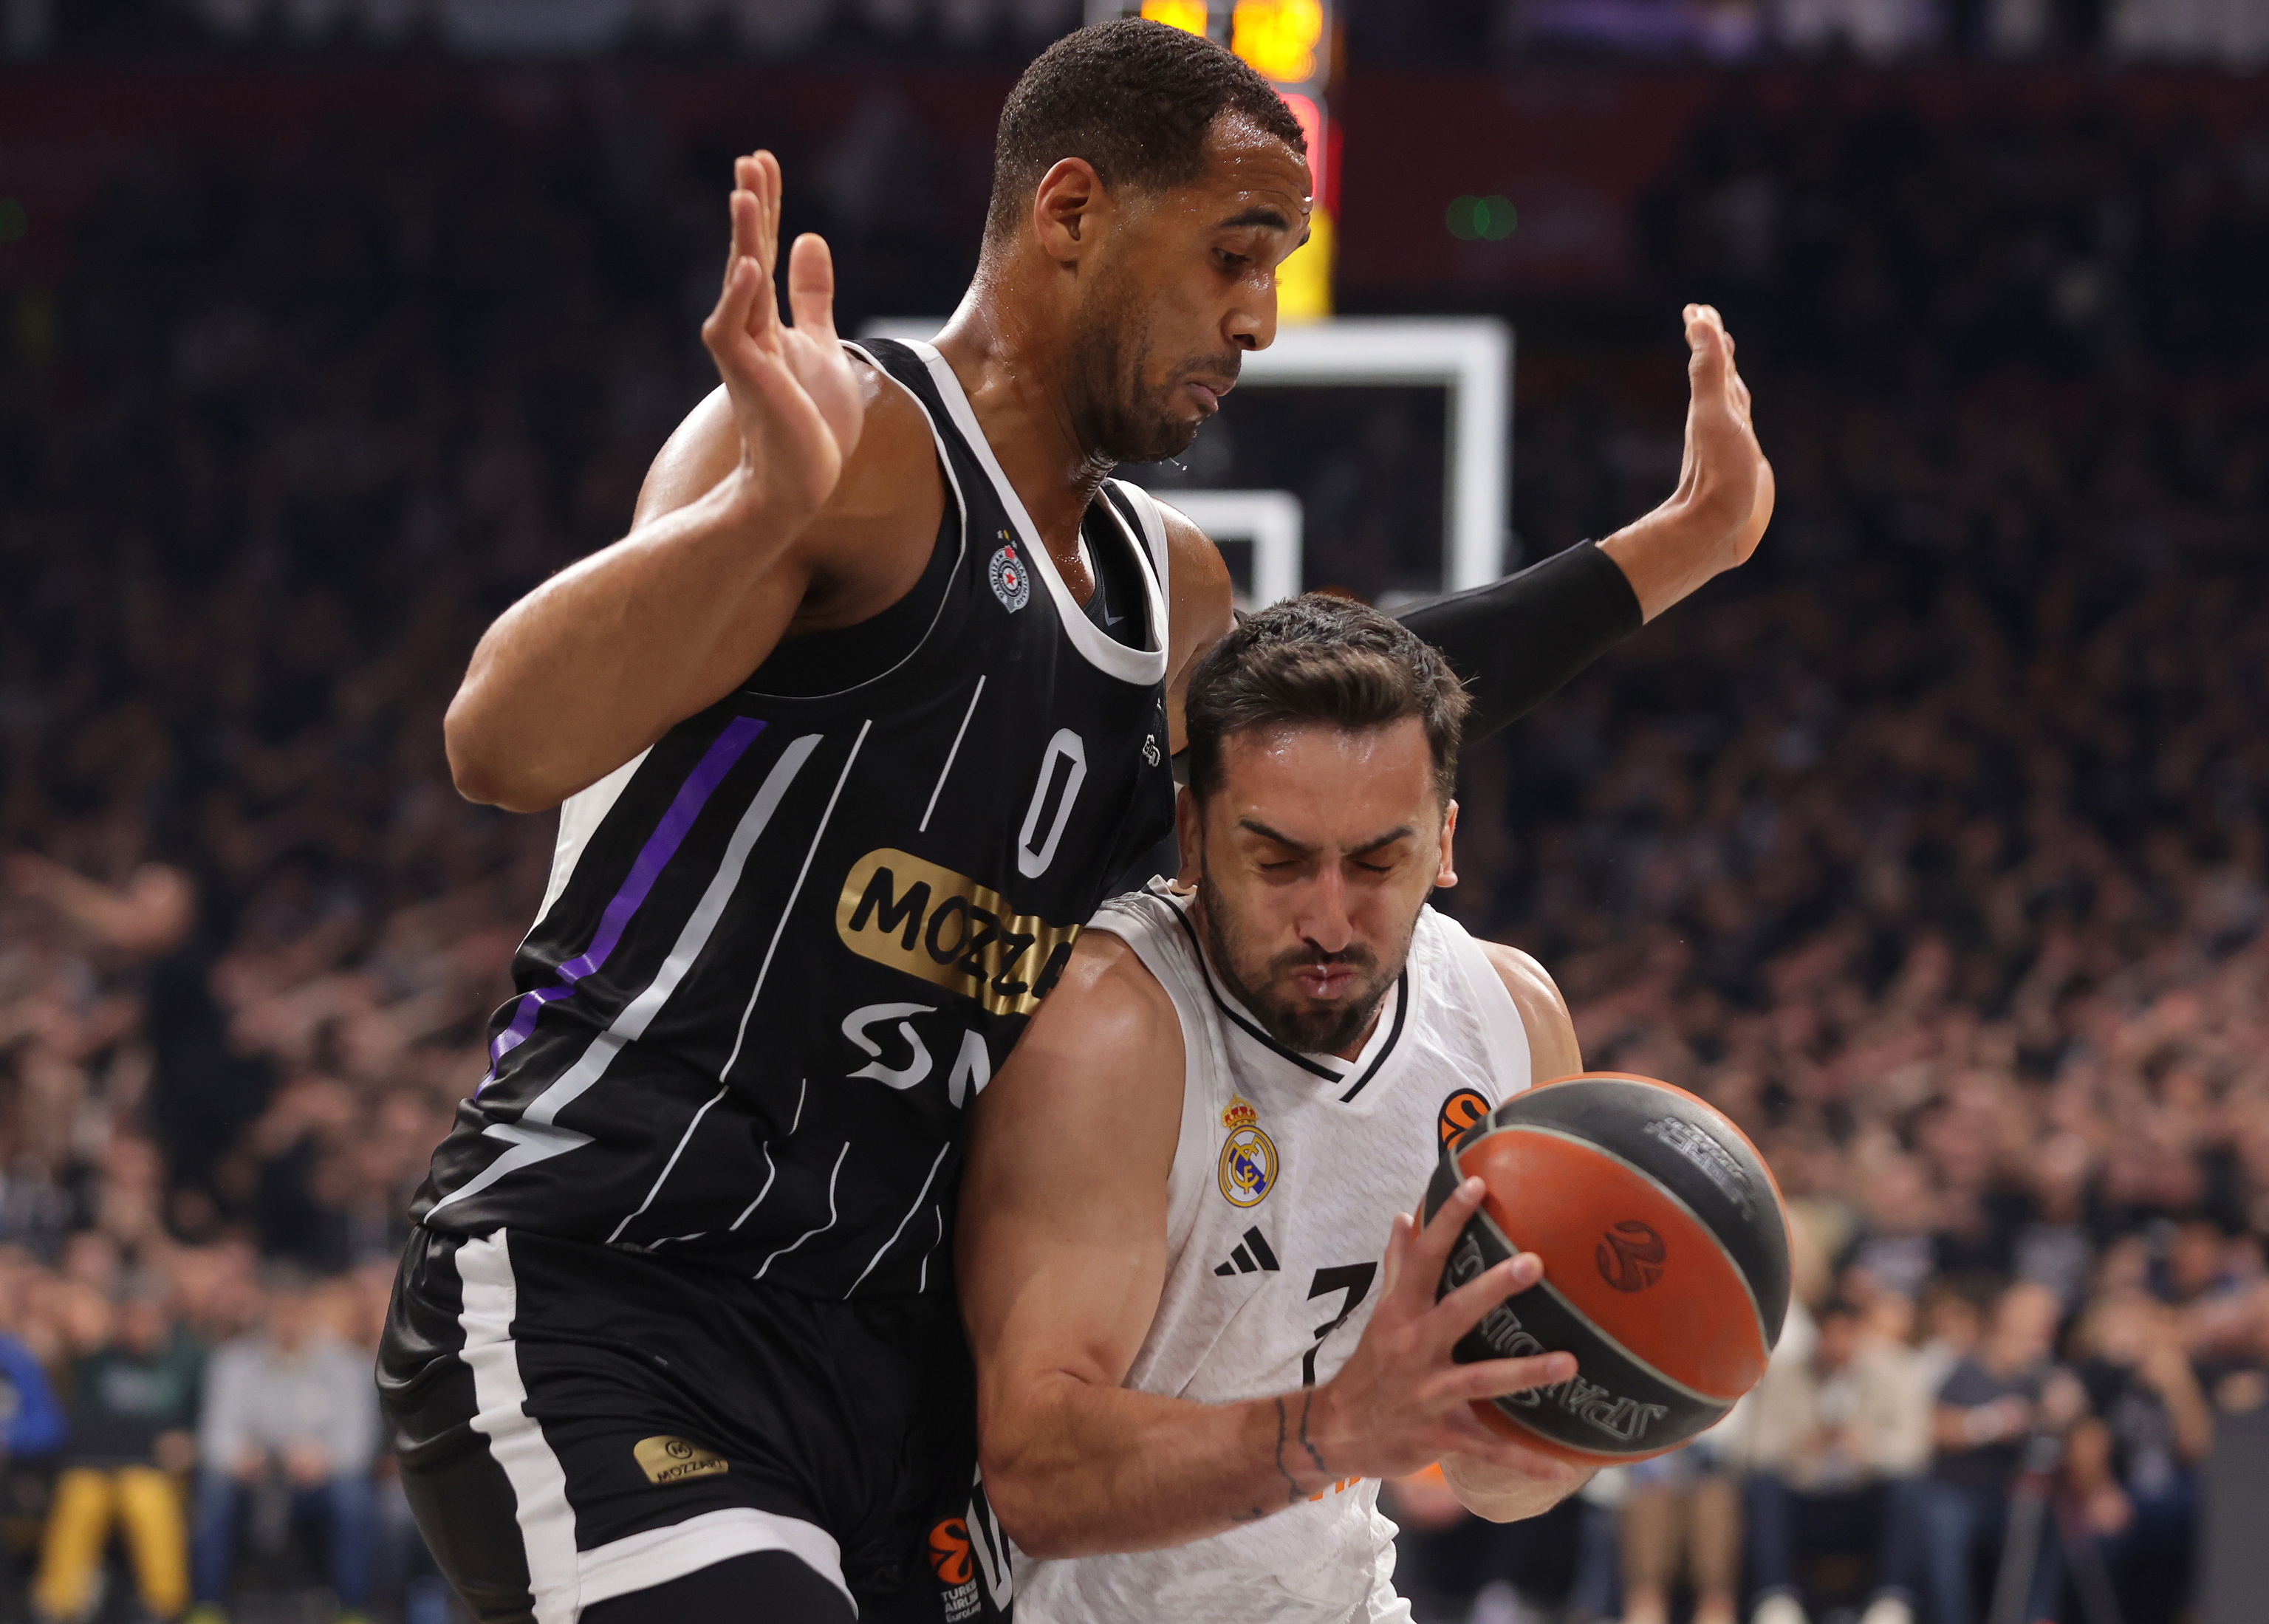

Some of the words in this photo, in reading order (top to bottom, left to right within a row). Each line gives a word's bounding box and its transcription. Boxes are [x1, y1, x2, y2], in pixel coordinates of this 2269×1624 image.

[1018, 727, 1087, 879] 0
[1302, 1261, 1378, 1388] 7
[1446, 1232, 1669, 1442] SPADIG
